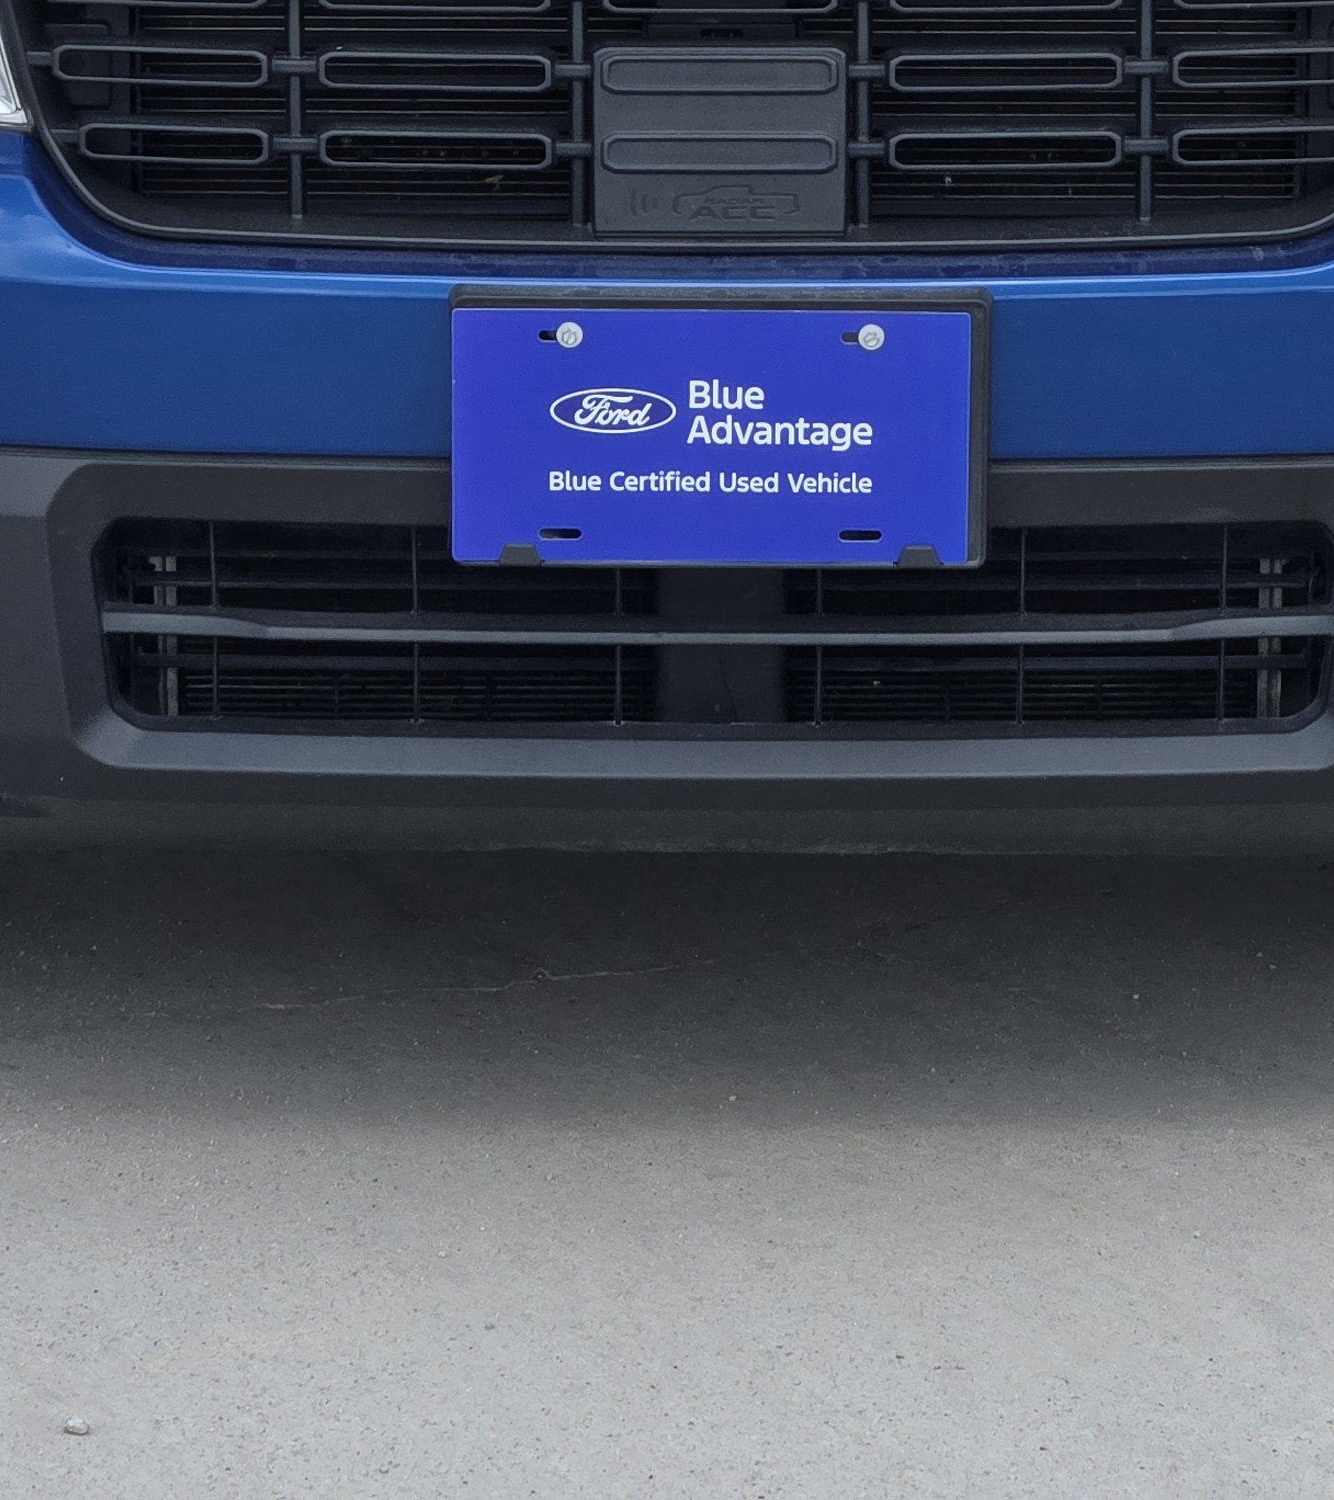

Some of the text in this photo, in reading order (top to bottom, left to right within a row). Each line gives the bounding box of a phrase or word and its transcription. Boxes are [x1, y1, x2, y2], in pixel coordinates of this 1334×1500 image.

[689, 205, 775, 221] ACC
[688, 379, 765, 410] Blue
[573, 393, 651, 428] Ford
[686, 414, 873, 452] Advantage
[549, 470, 873, 494] Blue Certified Used Vehicle
